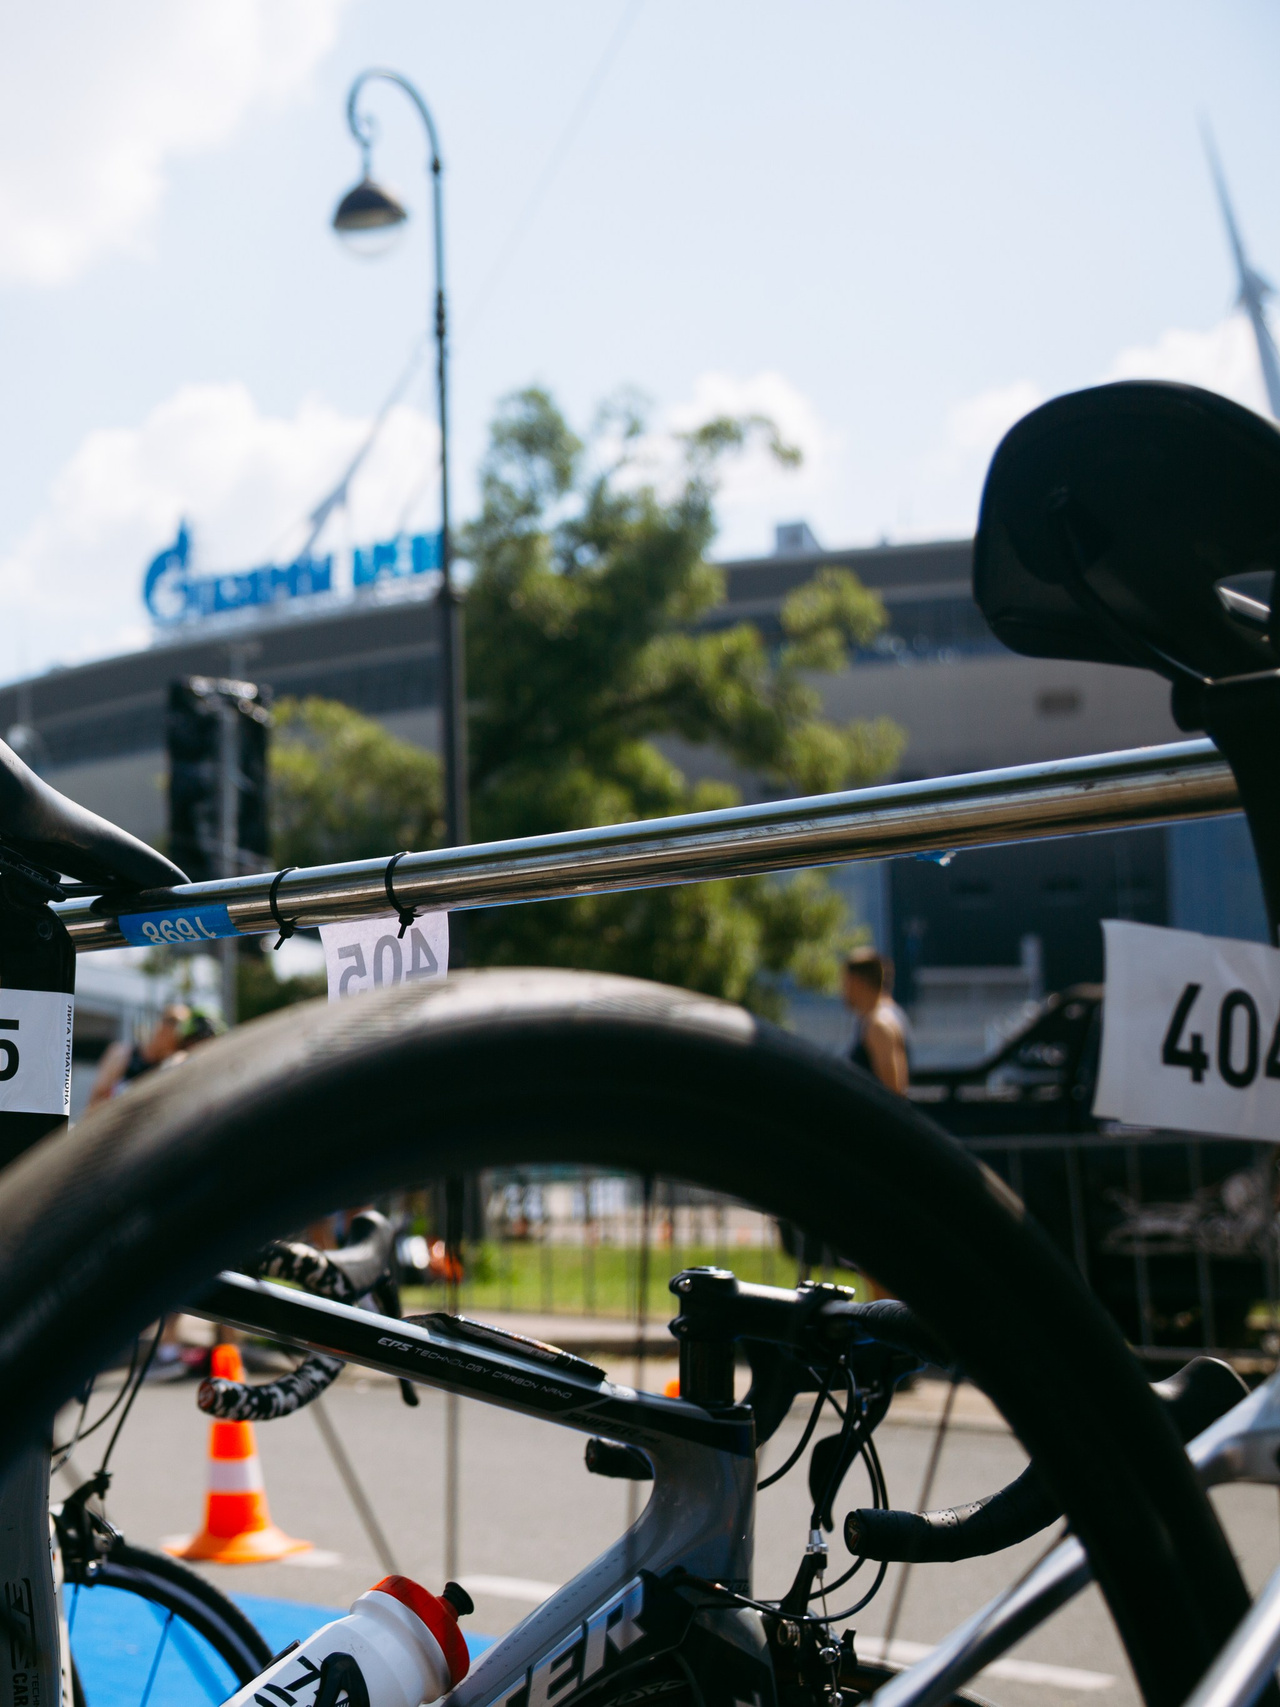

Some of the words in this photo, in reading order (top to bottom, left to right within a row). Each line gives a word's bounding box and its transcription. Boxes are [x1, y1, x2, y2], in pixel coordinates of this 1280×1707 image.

[142, 916, 217, 945] 1698
[64, 1038, 72, 1106] ТРИАТЛОНА
[377, 1336, 414, 1353] EPS
[414, 1346, 491, 1375] TECHNOLOGY
[491, 1369, 540, 1391] CARBON
[540, 1385, 573, 1401] NANO
